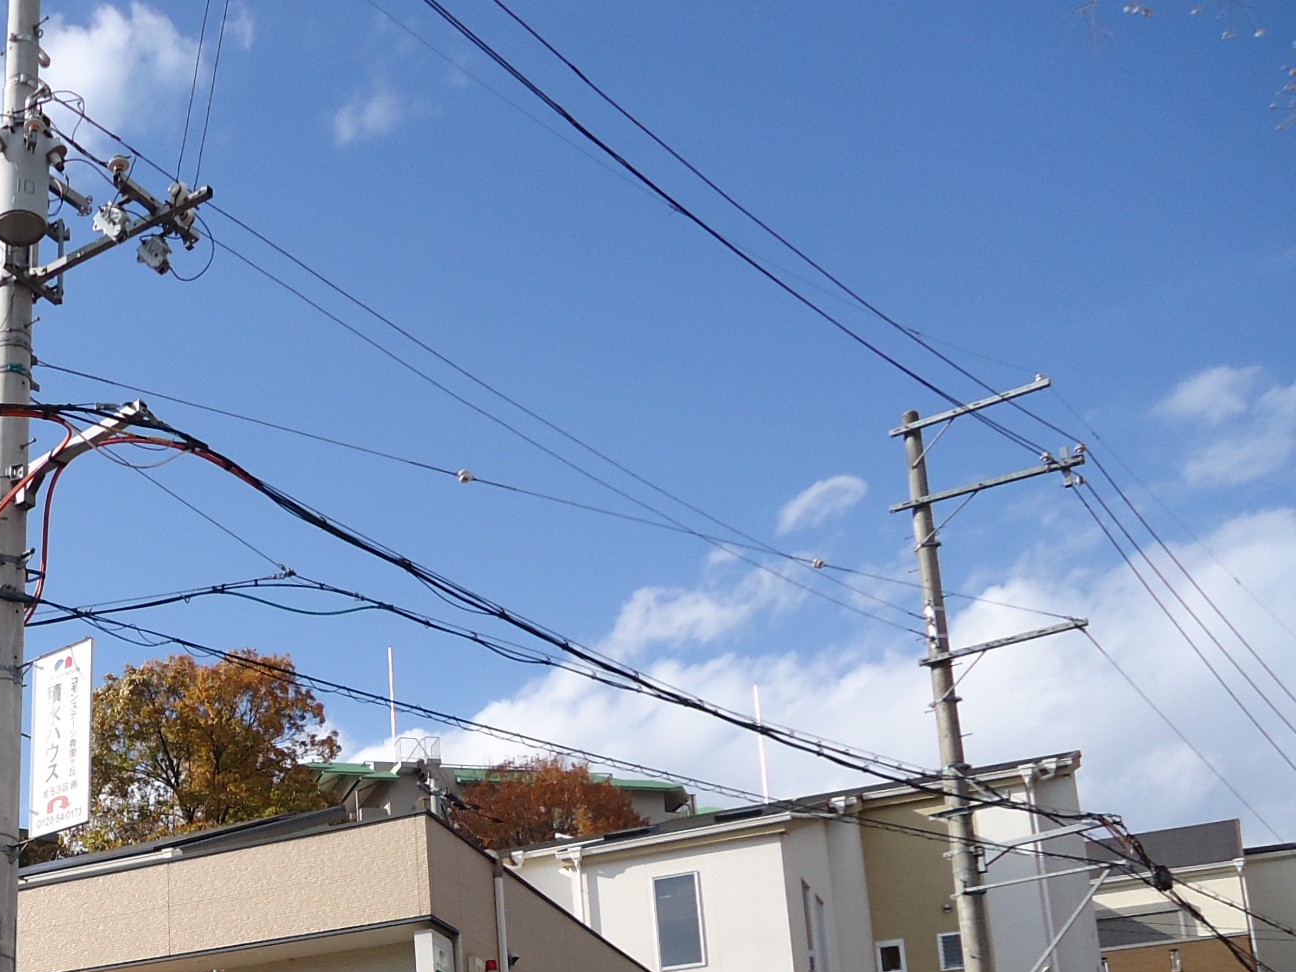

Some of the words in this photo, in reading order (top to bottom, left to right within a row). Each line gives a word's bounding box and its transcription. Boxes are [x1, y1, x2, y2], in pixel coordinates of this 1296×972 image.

[45, 683, 62, 784] 積水ハウス
